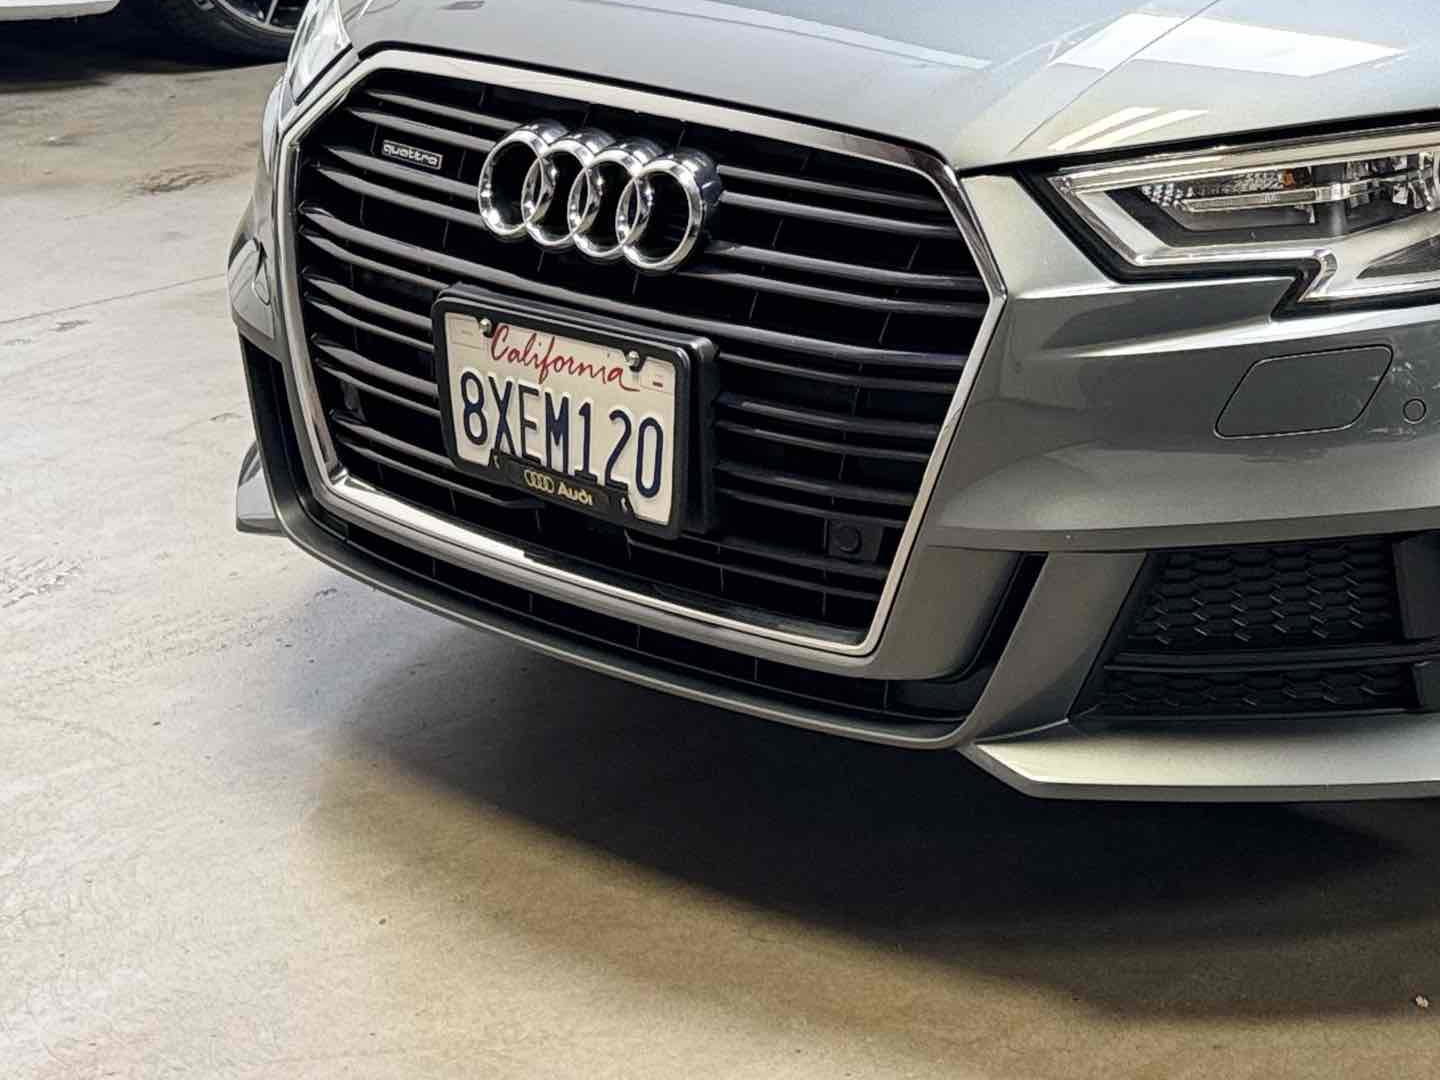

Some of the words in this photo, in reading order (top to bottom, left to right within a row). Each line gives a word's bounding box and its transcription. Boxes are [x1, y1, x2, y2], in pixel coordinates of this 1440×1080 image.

[383, 143, 439, 166] quattro
[490, 324, 641, 392] California
[460, 371, 663, 498] 8XEM120
[557, 480, 594, 506] Audi
